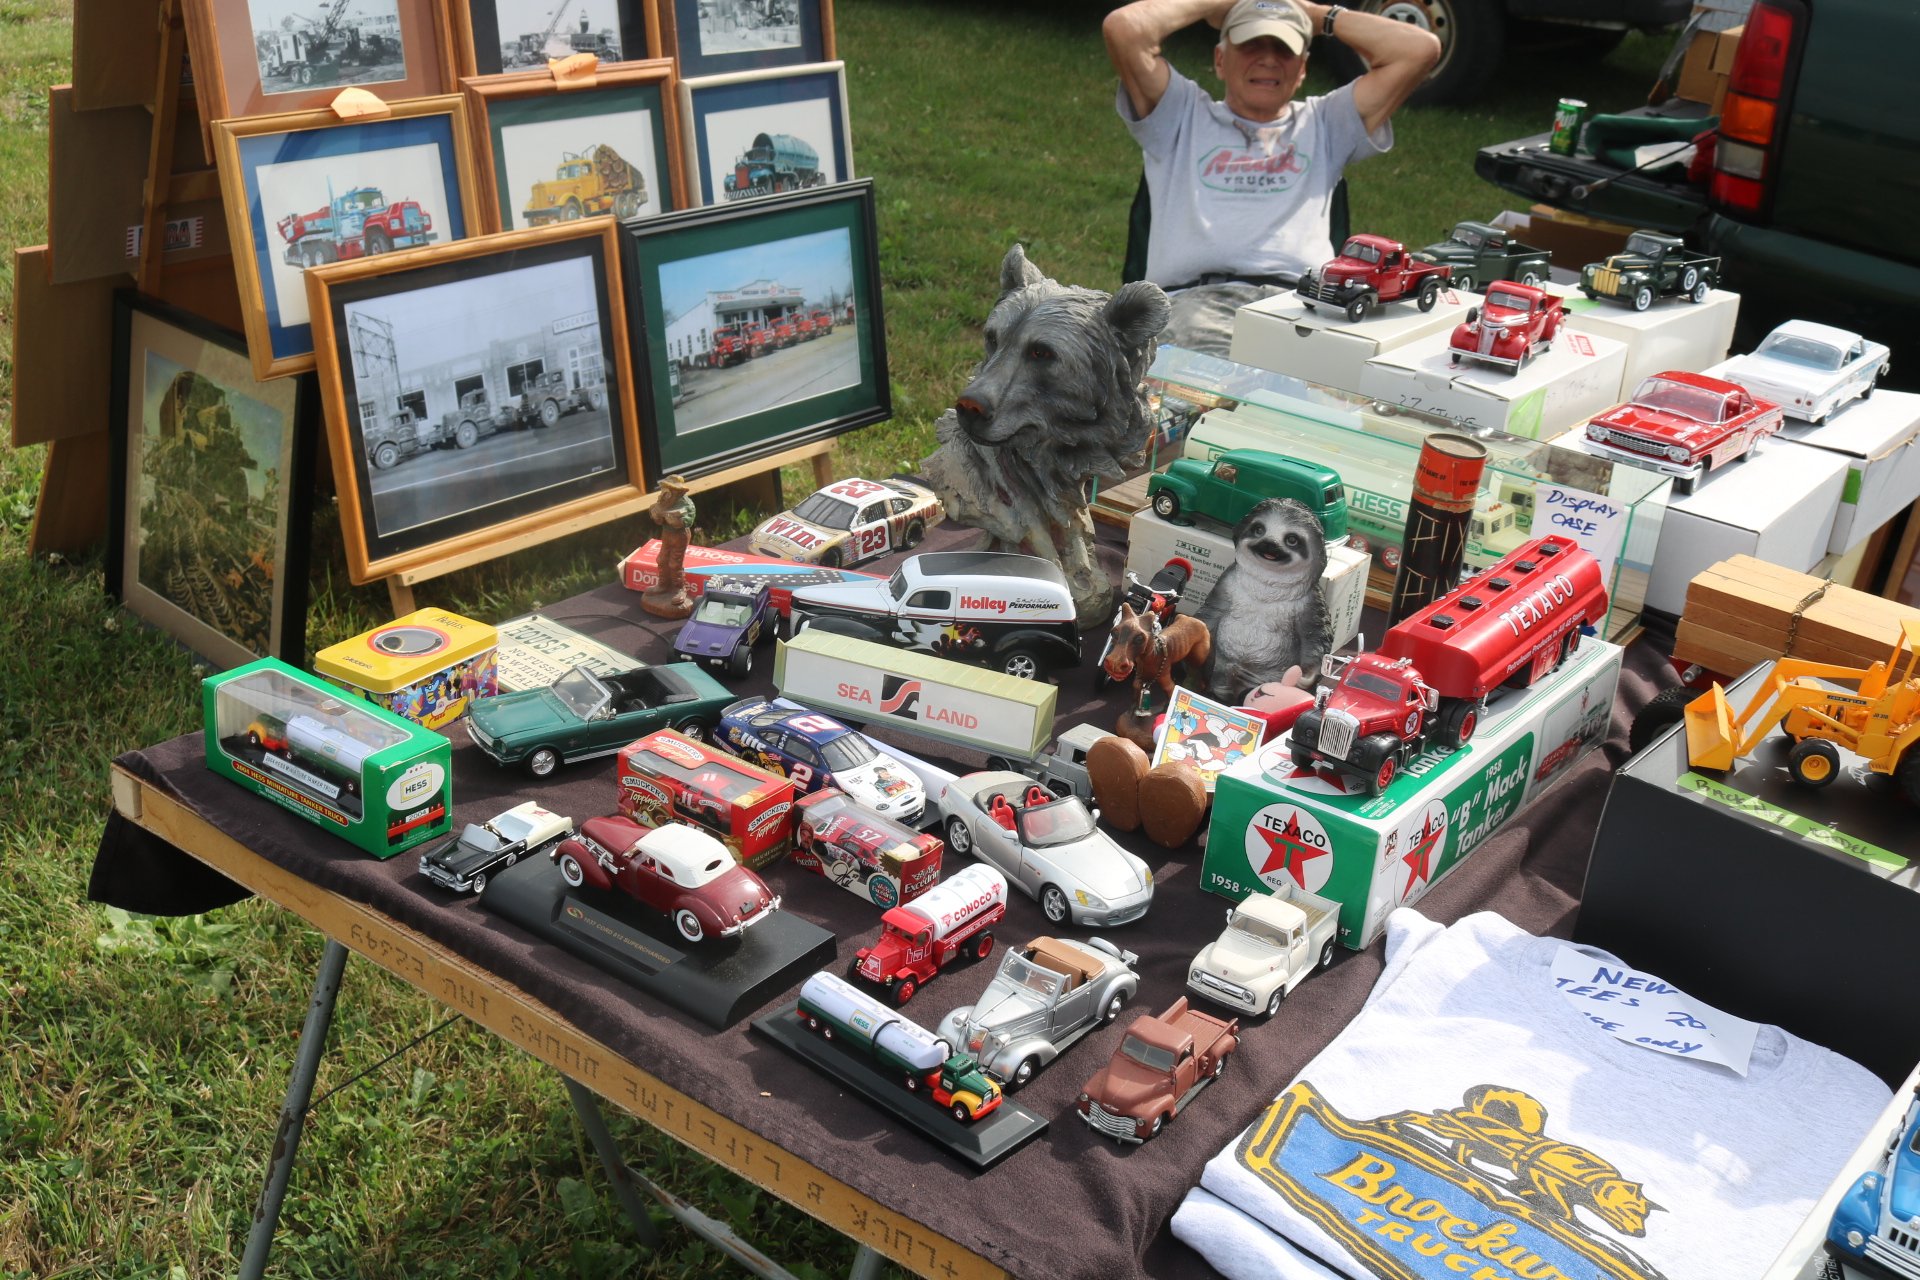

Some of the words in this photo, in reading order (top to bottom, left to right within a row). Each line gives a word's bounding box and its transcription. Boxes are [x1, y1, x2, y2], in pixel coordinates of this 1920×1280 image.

[1224, 175, 1287, 186] TRUCKS
[830, 480, 885, 499] 23
[1546, 490, 1618, 518] DISPLAY
[1352, 490, 1402, 519] HESS
[861, 525, 887, 554] 23
[960, 596, 1006, 614] Holley
[1009, 601, 1060, 610] PERFORMANCE
[1498, 574, 1574, 637] TEXACO
[504, 624, 571, 655] HOUSE
[508, 648, 523, 658] NO
[837, 683, 872, 704] SEA
[926, 705, 978, 730] LAND
[1402, 745, 1455, 778] Tanke
[1485, 759, 1502, 780] 1958
[405, 779, 427, 795] HESS
[789, 762, 814, 791] 2
[1483, 755, 1528, 811] Mack
[236, 763, 249, 774] 2004
[250, 771, 265, 782] HESS
[266, 779, 298, 799] MINIATURE
[299, 795, 323, 812] TANKER
[323, 807, 344, 822] TRUCK
[409, 809, 426, 821] 2004
[749, 803, 790, 831] SMUCKERS
[1455, 800, 1510, 859] Tanker
[855, 829, 882, 843] 57
[1263, 814, 1326, 848] TEXACO
[1409, 811, 1445, 850] TEXACO
[1274, 837, 1307, 868] T
[1414, 840, 1434, 876] T
[904, 869, 940, 894] Excedrin
[1211, 872, 1240, 893] 1958
[954, 891, 992, 922] CONOCO
[595, 923, 612, 936] CORD
[622, 936, 671, 964] SUPERCHARGED
[860, 969, 880, 982] CONOCO
[1591, 967, 1679, 995] NEW
[1555, 977, 1640, 1008] TEES
[853, 1015, 870, 1030] HESS
